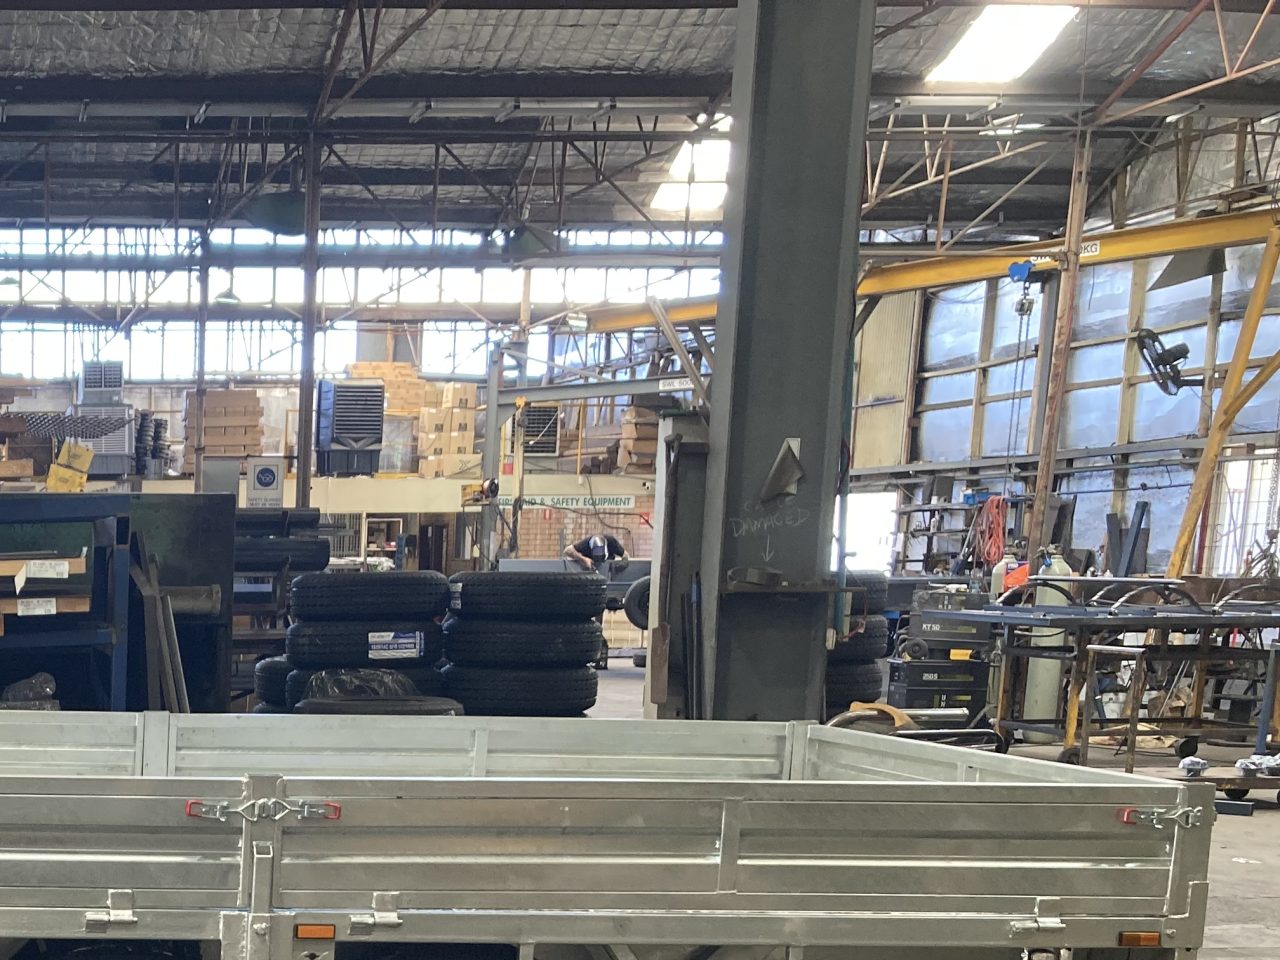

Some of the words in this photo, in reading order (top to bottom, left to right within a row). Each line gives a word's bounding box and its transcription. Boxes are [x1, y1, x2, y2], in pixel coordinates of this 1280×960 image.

[550, 496, 579, 506] SAFETY
[583, 496, 631, 506] EQUIPMENT
[729, 508, 810, 537] DAMAGED
